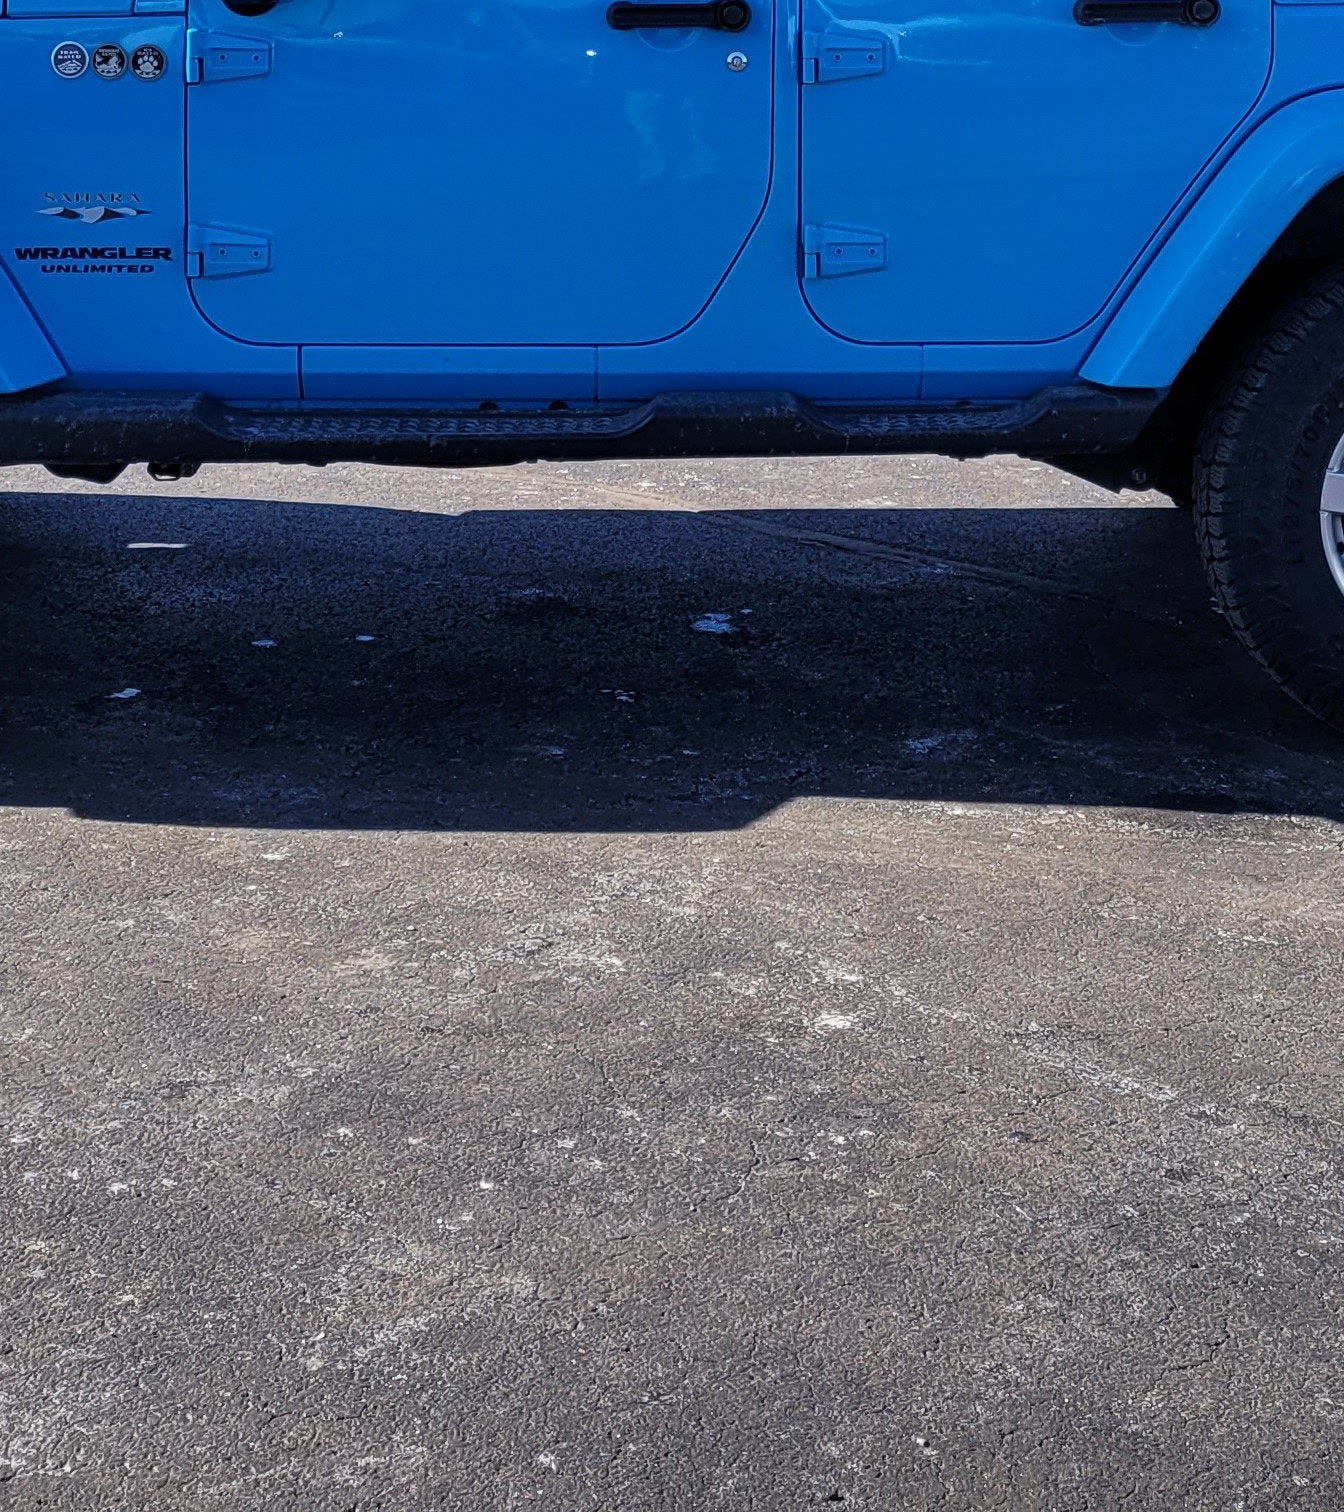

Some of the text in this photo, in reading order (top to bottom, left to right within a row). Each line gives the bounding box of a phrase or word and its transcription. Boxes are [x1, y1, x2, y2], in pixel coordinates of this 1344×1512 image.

[43, 192, 142, 203] SAHARA
[14, 247, 174, 261] WRANGLER
[41, 264, 155, 274] UNLIMITED
